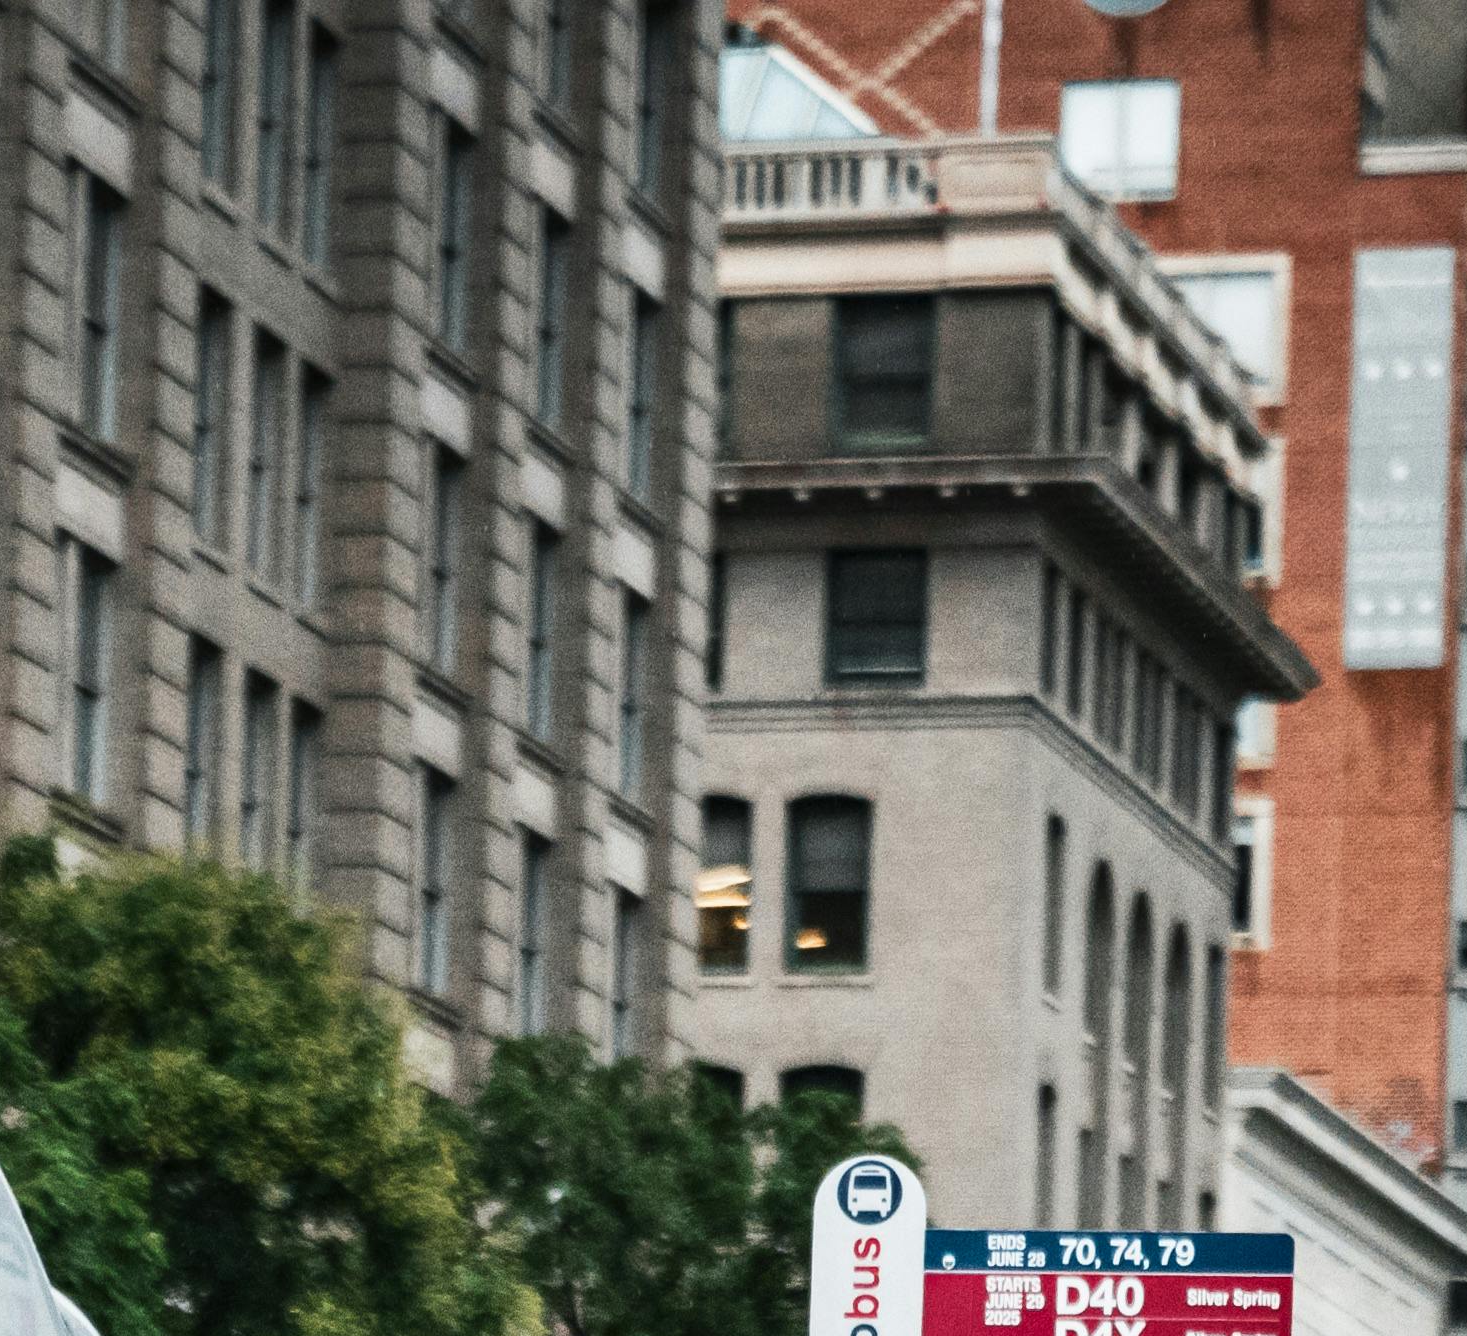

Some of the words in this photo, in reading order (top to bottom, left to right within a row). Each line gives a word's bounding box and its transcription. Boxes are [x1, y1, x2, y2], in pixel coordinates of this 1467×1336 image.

[987, 1234, 1026, 1251] ENDS
[987, 1252, 1024, 1267] JUNE
[1027, 1252, 1045, 1267] 28
[1059, 1238, 1101, 1268] 70,
[1110, 1239, 1149, 1268] 74,
[1158, 1239, 1195, 1266] 79
[986, 1276, 1042, 1293] STARTS
[985, 1293, 1023, 1309] JUNE
[1055, 1276, 1145, 1316] D40
[1186, 1288, 1229, 1307] Silver
[1232, 1290, 1281, 1310] Spring
[984, 1310, 1021, 1326] 2025
